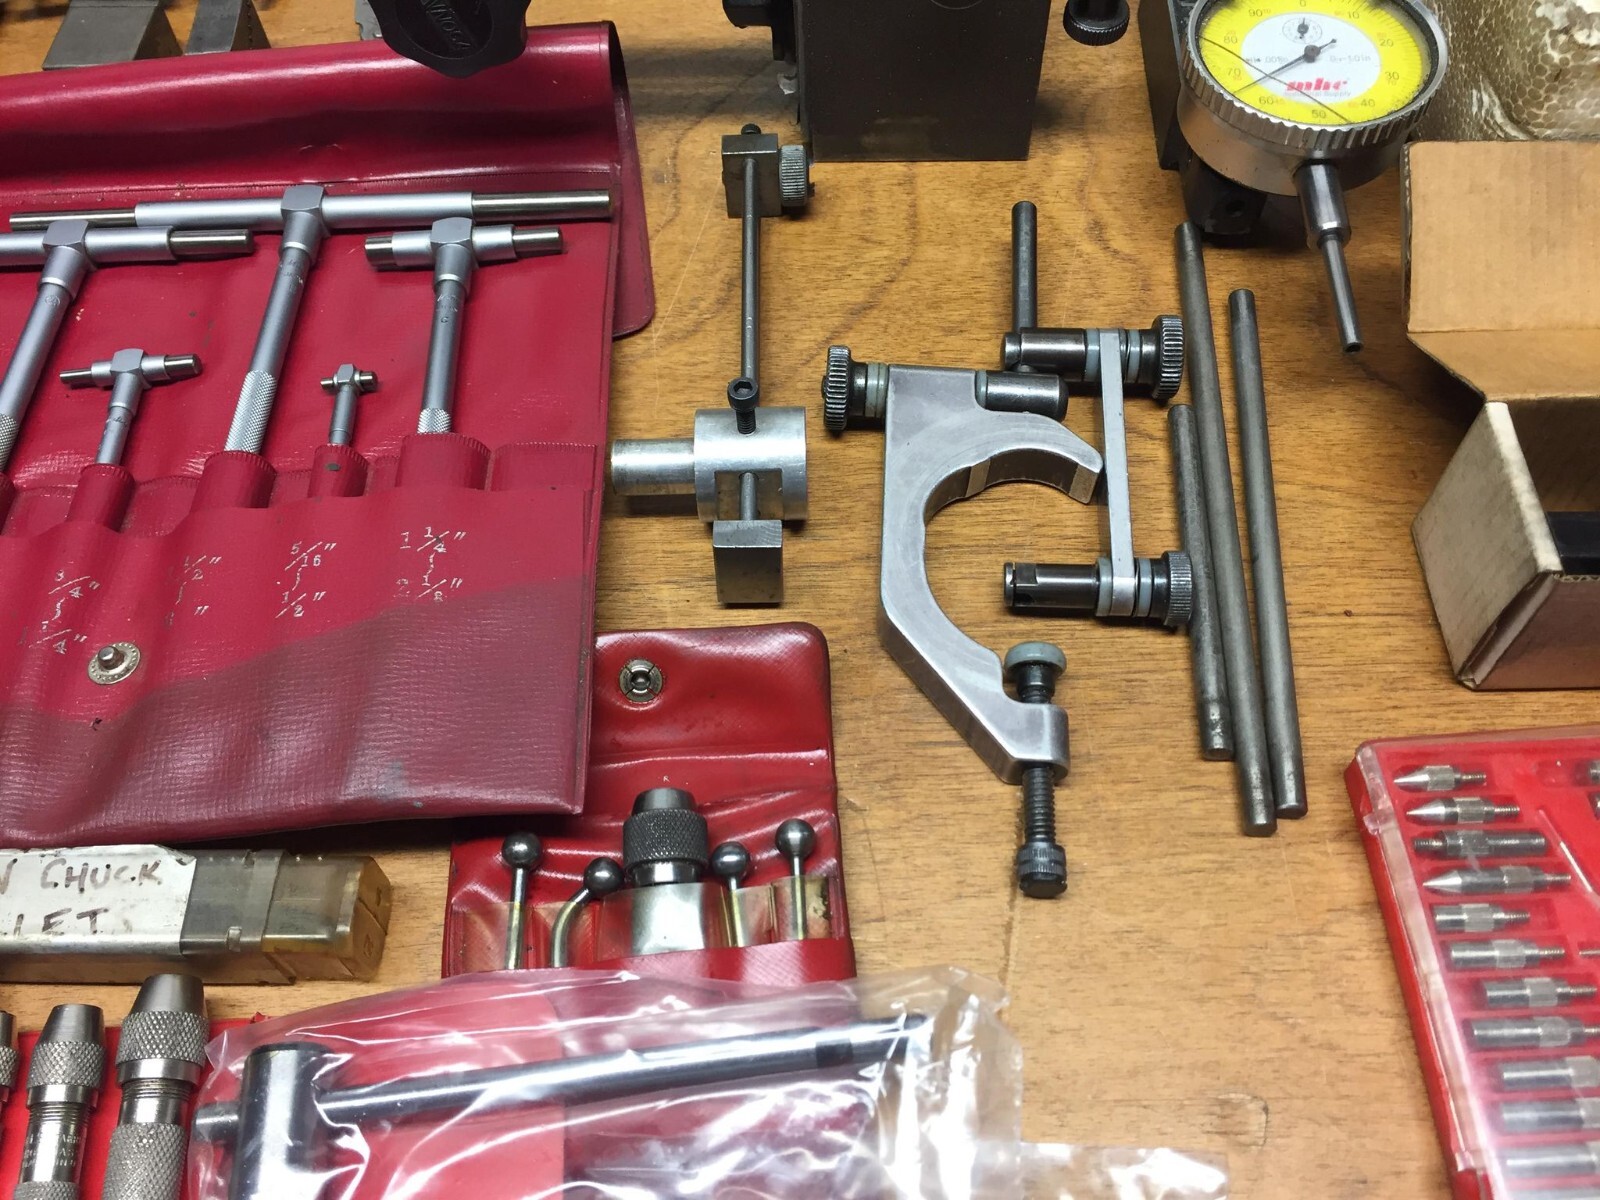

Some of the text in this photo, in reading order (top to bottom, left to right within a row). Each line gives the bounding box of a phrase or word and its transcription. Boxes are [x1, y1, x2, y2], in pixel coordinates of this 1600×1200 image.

[1248, 8, 1263, 17] 90
[1347, 11, 1360, 19] 10
[1223, 35, 1238, 44] 80
[1379, 39, 1394, 47] 20
[1226, 67, 1242, 77] 70
[1385, 71, 1400, 80] 30
[1258, 96, 1274, 105] 60
[1360, 98, 1376, 107] 40
[1311, 109, 1327, 119] 50
[40, 857, 163, 894] CHUCK
